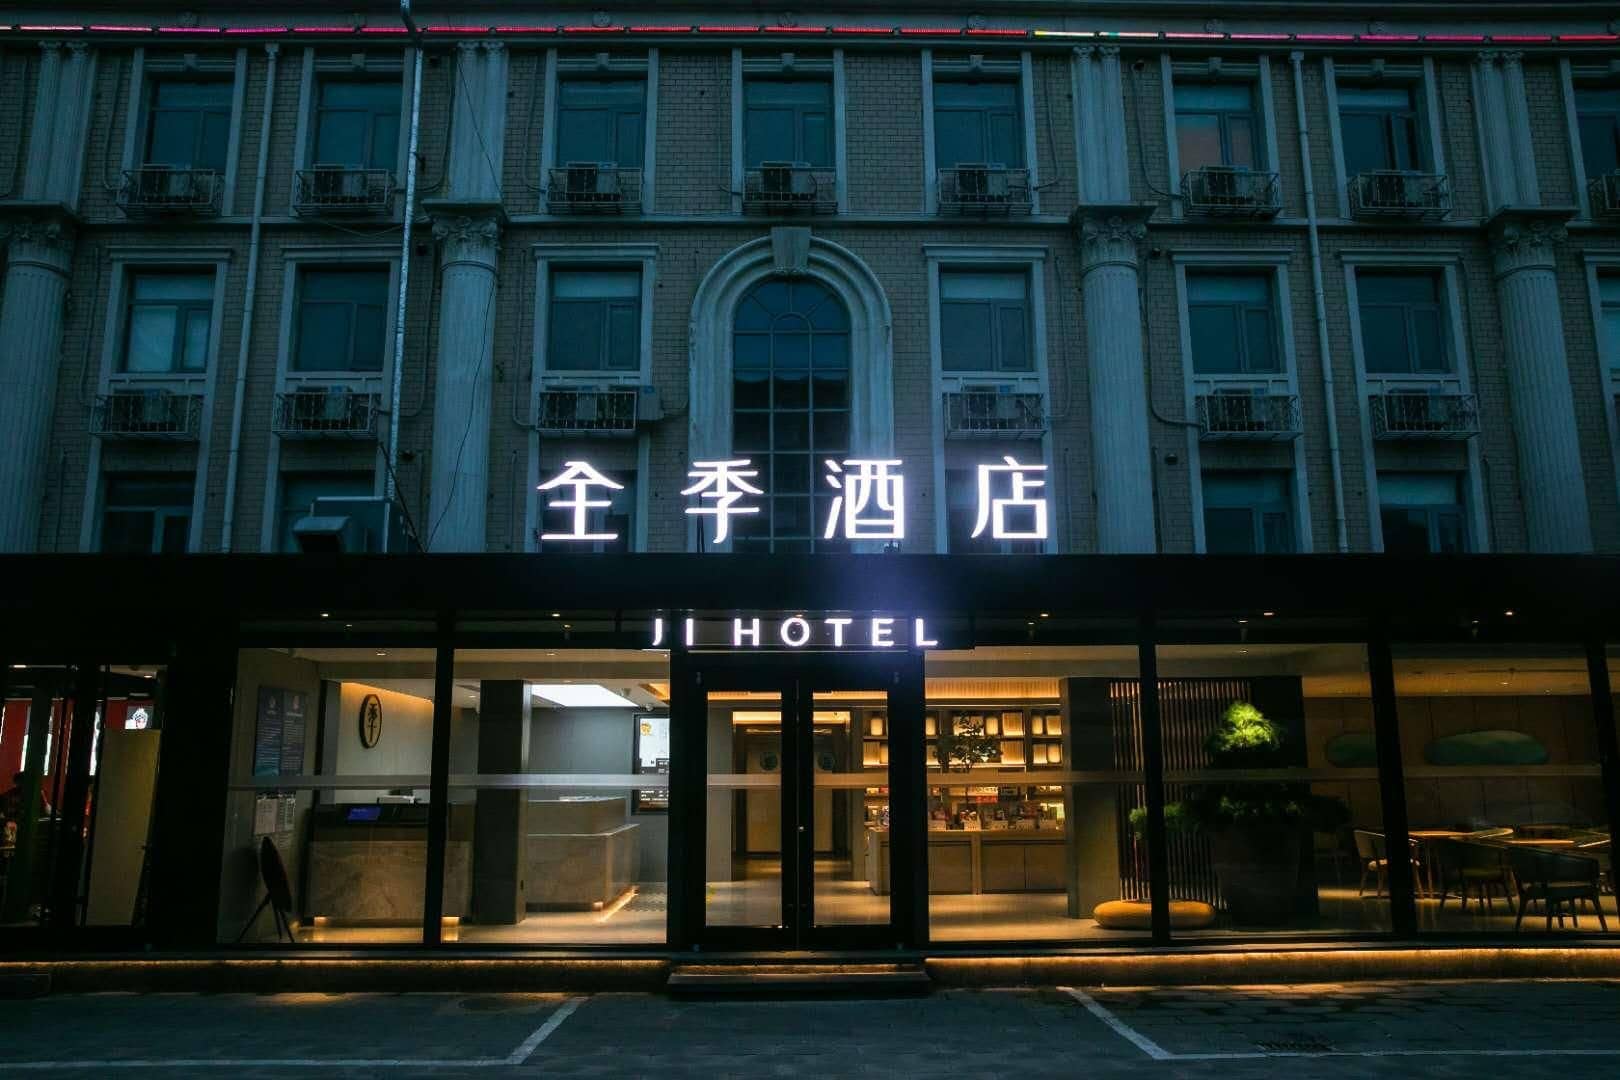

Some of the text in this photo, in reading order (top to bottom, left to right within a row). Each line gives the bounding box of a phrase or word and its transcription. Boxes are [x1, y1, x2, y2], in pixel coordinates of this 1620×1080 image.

[537, 456, 1049, 543] 全季酒店
[652, 618, 938, 646] JI HOTEL
